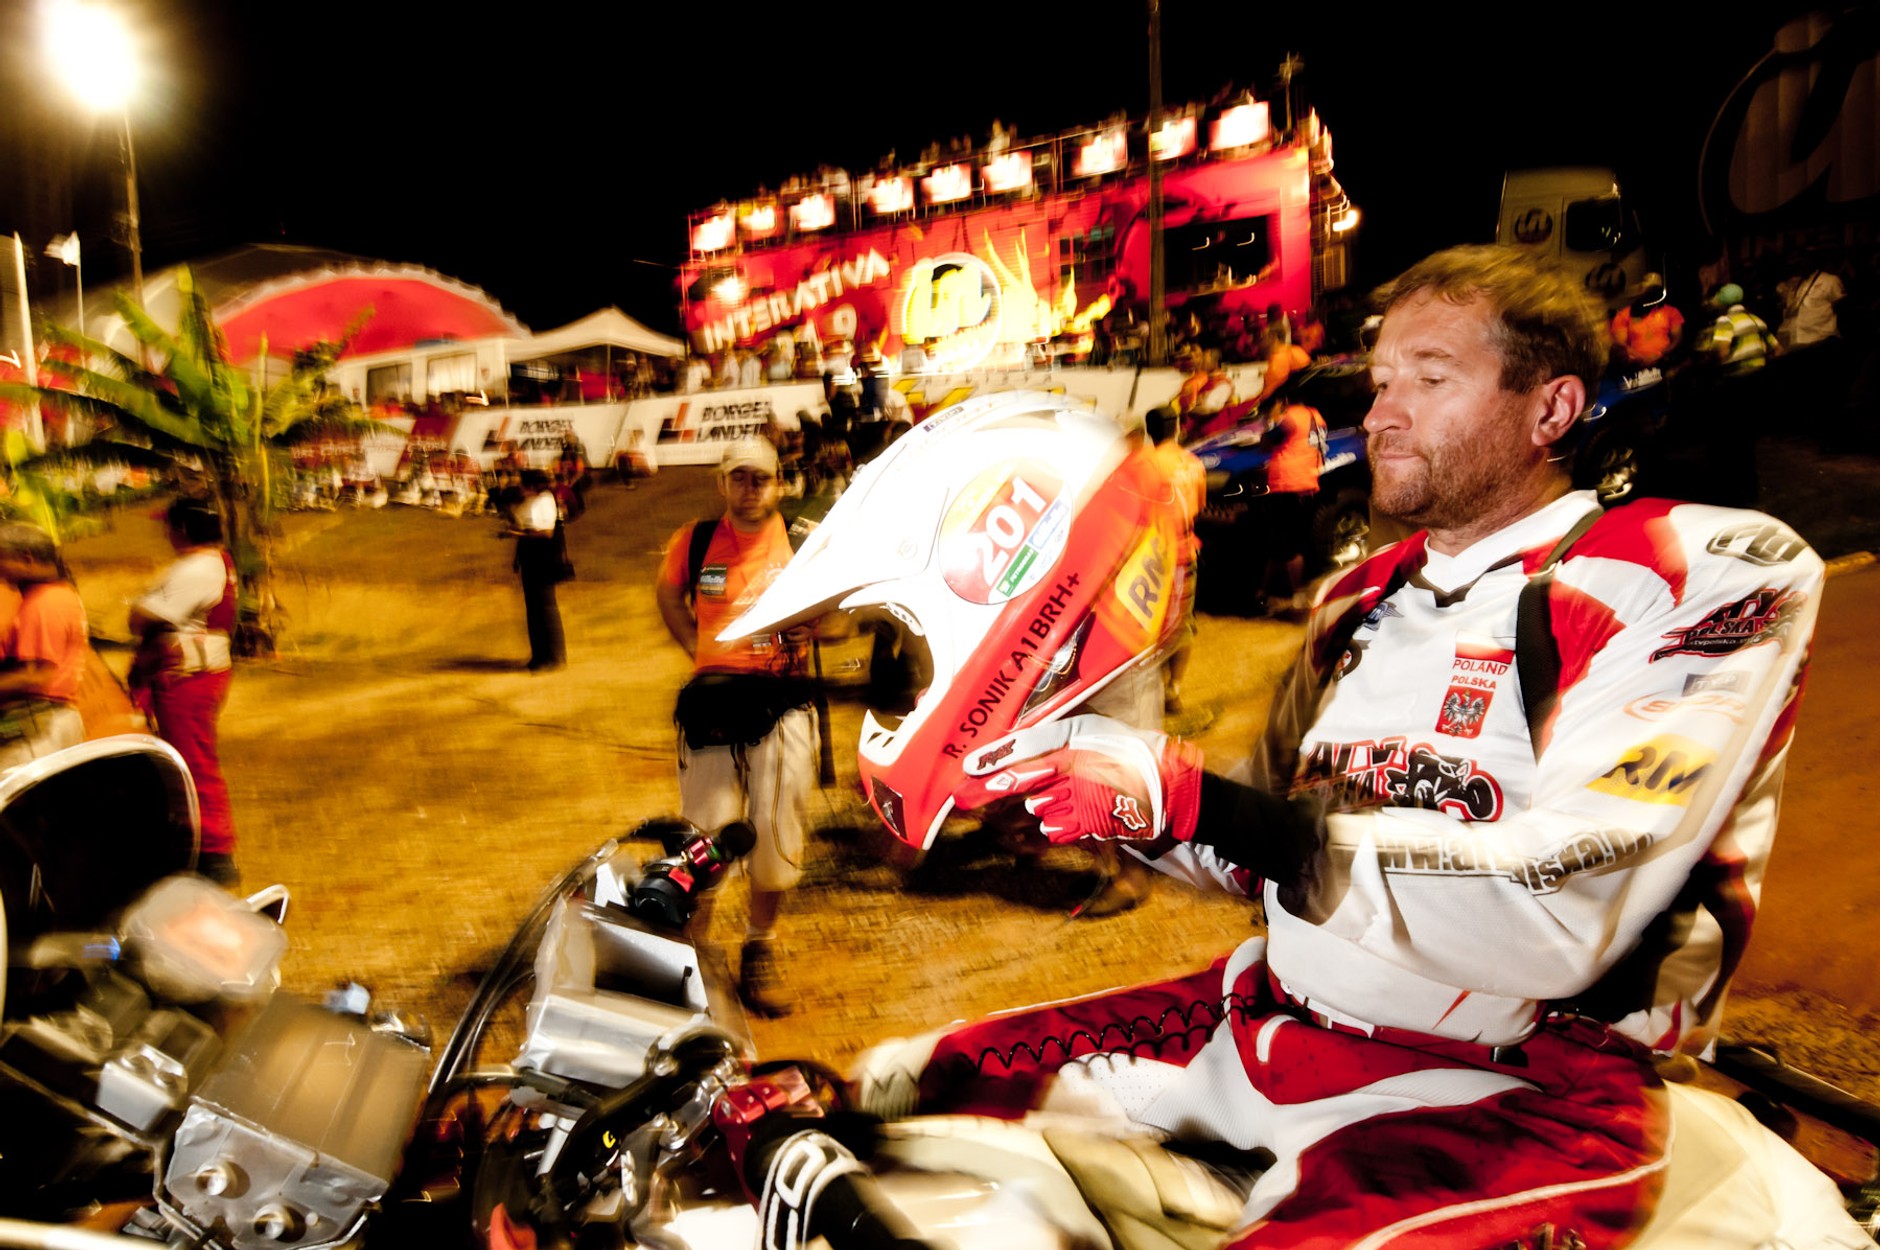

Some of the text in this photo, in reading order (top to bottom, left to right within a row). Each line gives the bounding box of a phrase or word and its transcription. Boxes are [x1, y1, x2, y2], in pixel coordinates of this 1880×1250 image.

[703, 247, 890, 354] INTERATIVA
[972, 476, 1047, 587] 201
[1451, 675, 1497, 689] POLSKA
[1452, 659, 1509, 676] POLAND
[960, 669, 1017, 738] SONIK
